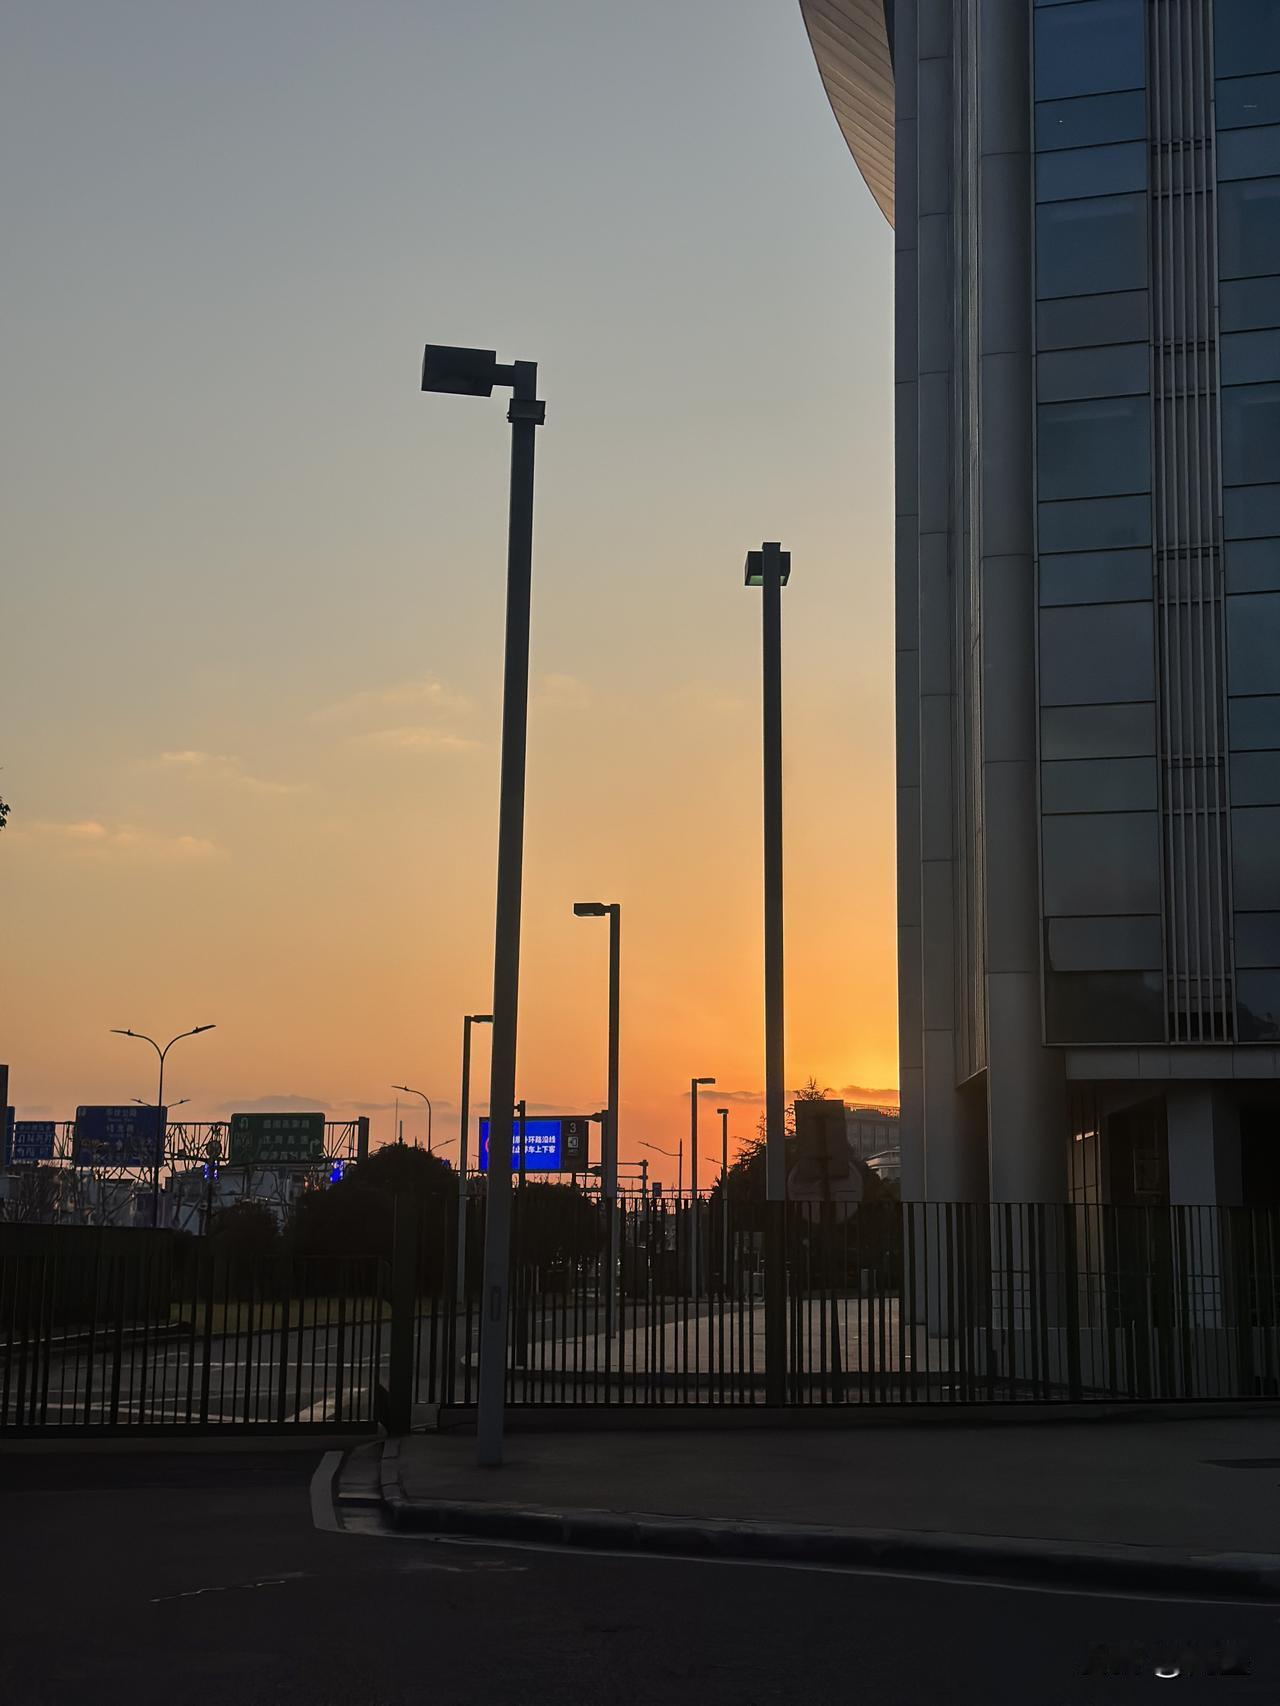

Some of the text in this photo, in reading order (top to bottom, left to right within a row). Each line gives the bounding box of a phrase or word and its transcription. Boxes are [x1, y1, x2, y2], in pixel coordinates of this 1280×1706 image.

[569, 1122, 577, 1133] 3
[512, 1135, 556, 1144] 展环路沿线
[512, 1145, 556, 1154] 止车上下客
